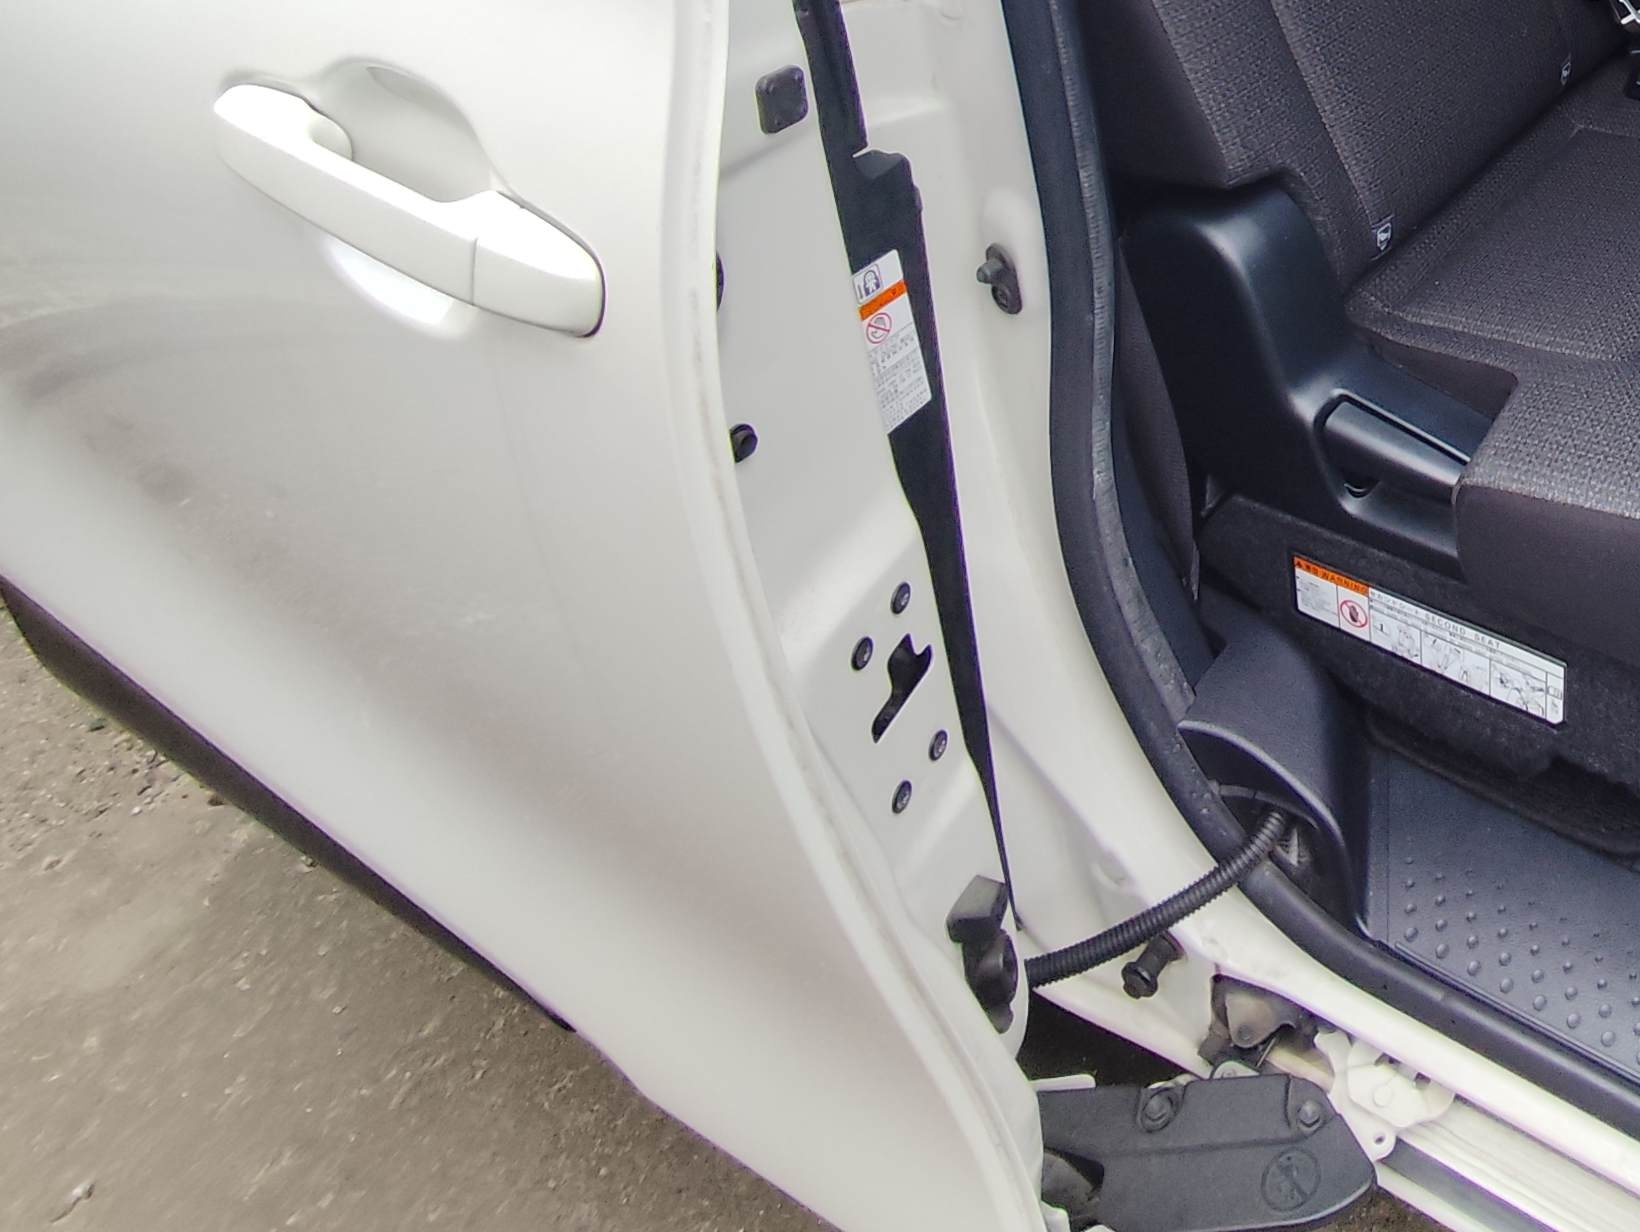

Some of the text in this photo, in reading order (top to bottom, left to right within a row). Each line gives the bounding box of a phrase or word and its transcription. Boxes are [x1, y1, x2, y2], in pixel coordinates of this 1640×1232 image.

[1321, 571, 1368, 593] WARNING
[1424, 613, 1466, 636] SECOND
[1473, 633, 1501, 649] SEAT
